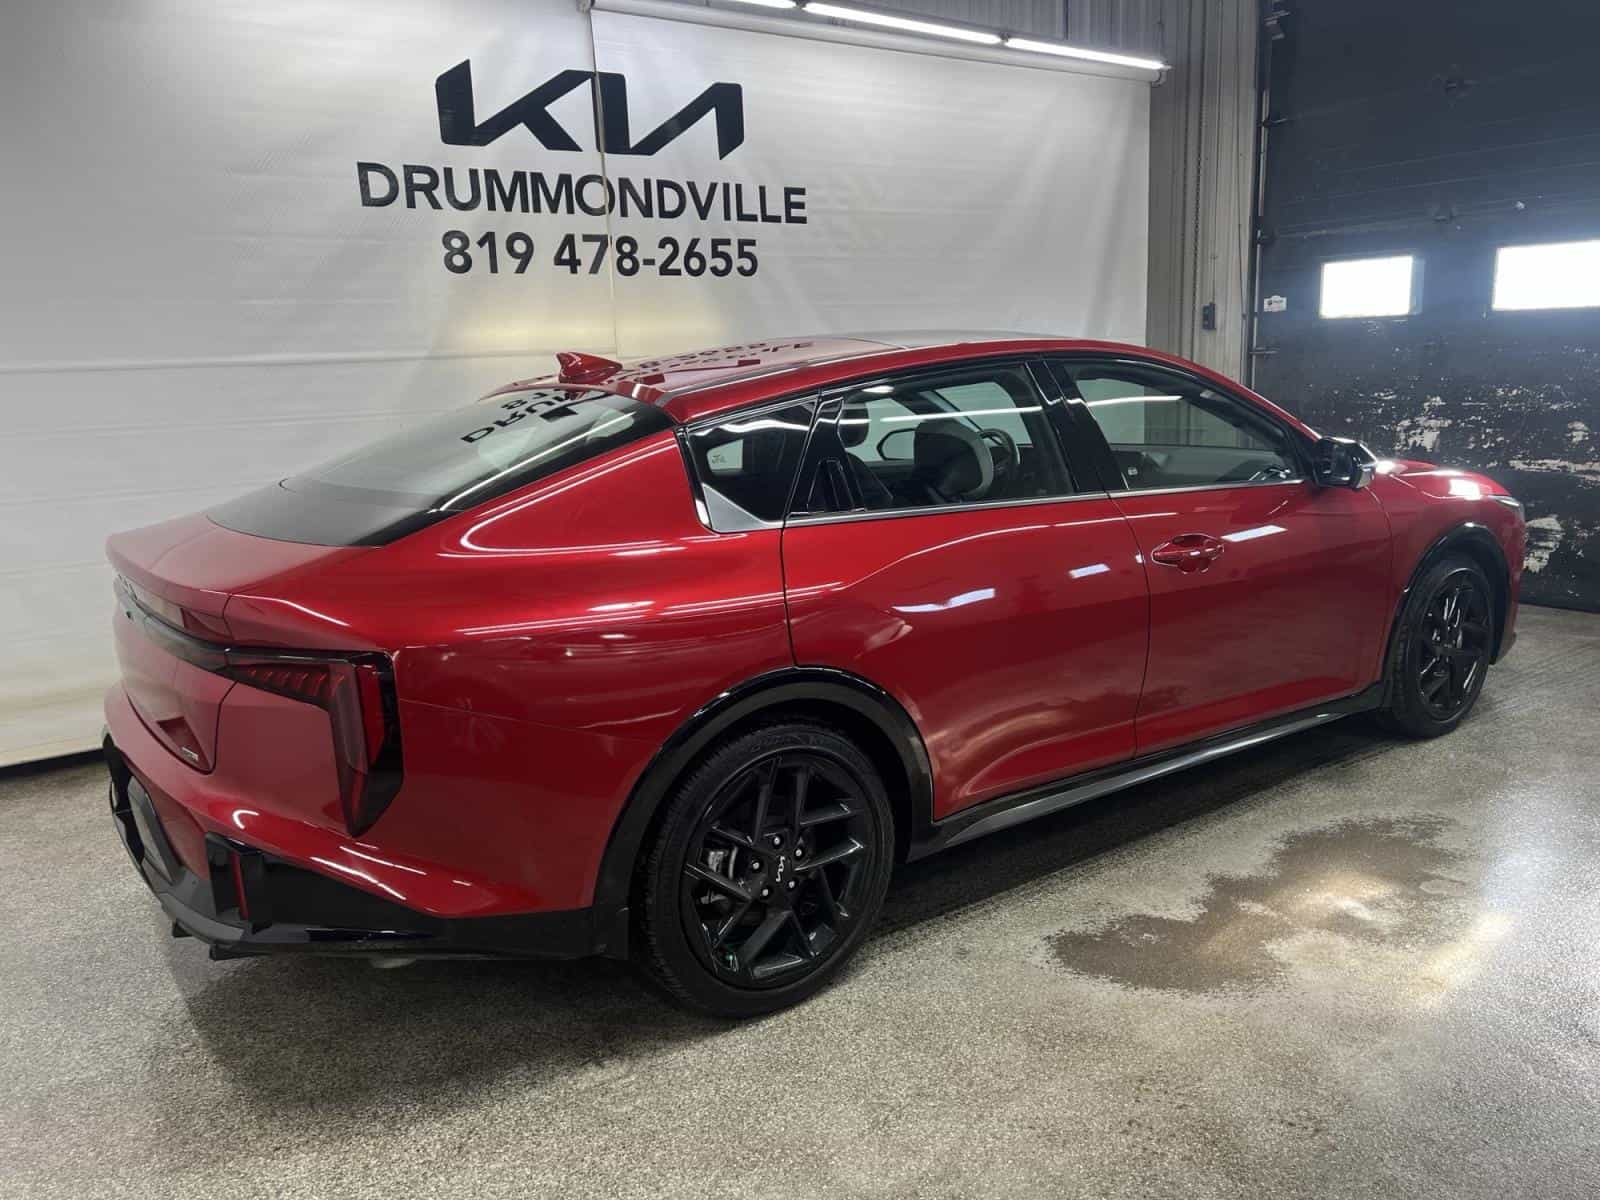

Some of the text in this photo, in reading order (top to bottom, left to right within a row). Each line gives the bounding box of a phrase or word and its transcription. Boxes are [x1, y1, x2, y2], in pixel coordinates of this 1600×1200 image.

[435, 58, 745, 161] KIA
[356, 161, 808, 225] DRUMMONDVILLE
[441, 230, 760, 278] 819 478-2655
